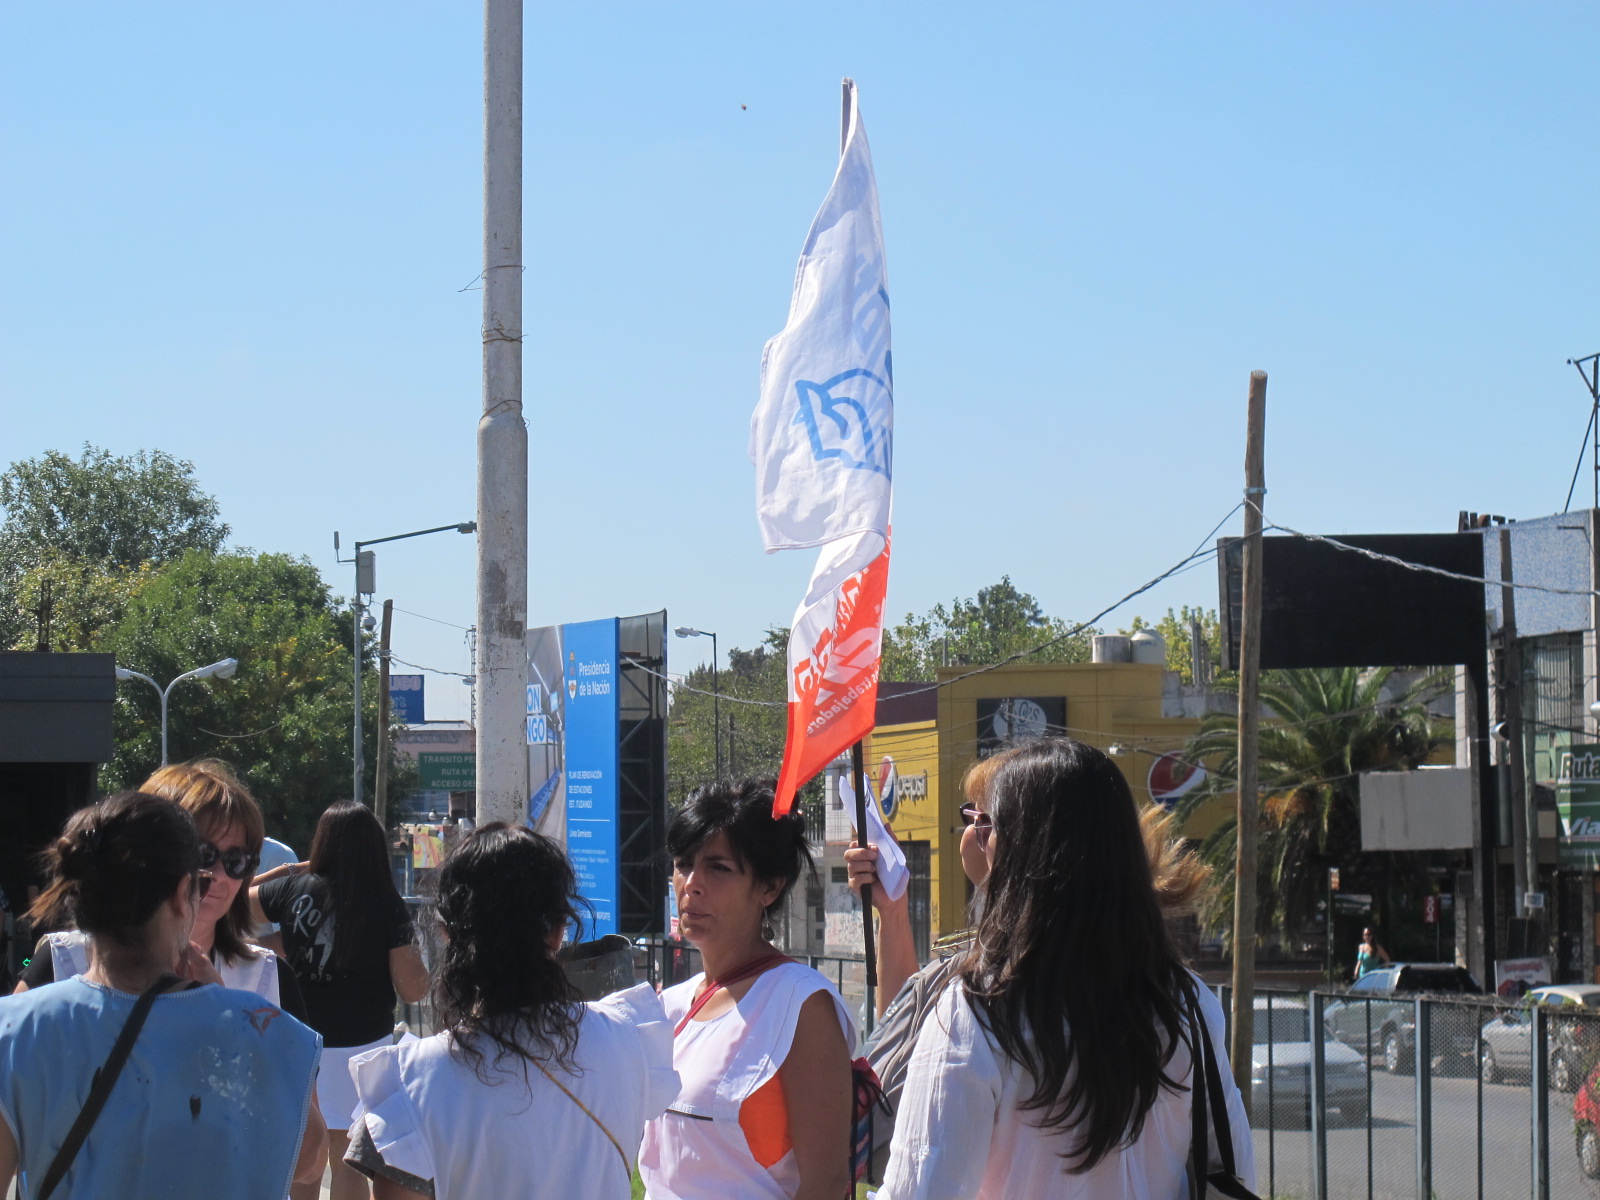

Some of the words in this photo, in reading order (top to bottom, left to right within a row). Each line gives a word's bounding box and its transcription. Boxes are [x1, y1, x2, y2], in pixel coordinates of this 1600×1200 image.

[579, 660, 610, 676] Presidencia
[579, 681, 586, 696] de
[587, 681, 592, 696] la
[592, 680, 610, 695] Nación
[527, 687, 540, 711] ON
[527, 717, 545, 742] NGO
[423, 755, 462, 763] TRANSITO
[441, 768, 460, 776] RUTA
[431, 779, 462, 787] ACCESO
[897, 769, 928, 803] pepsi
